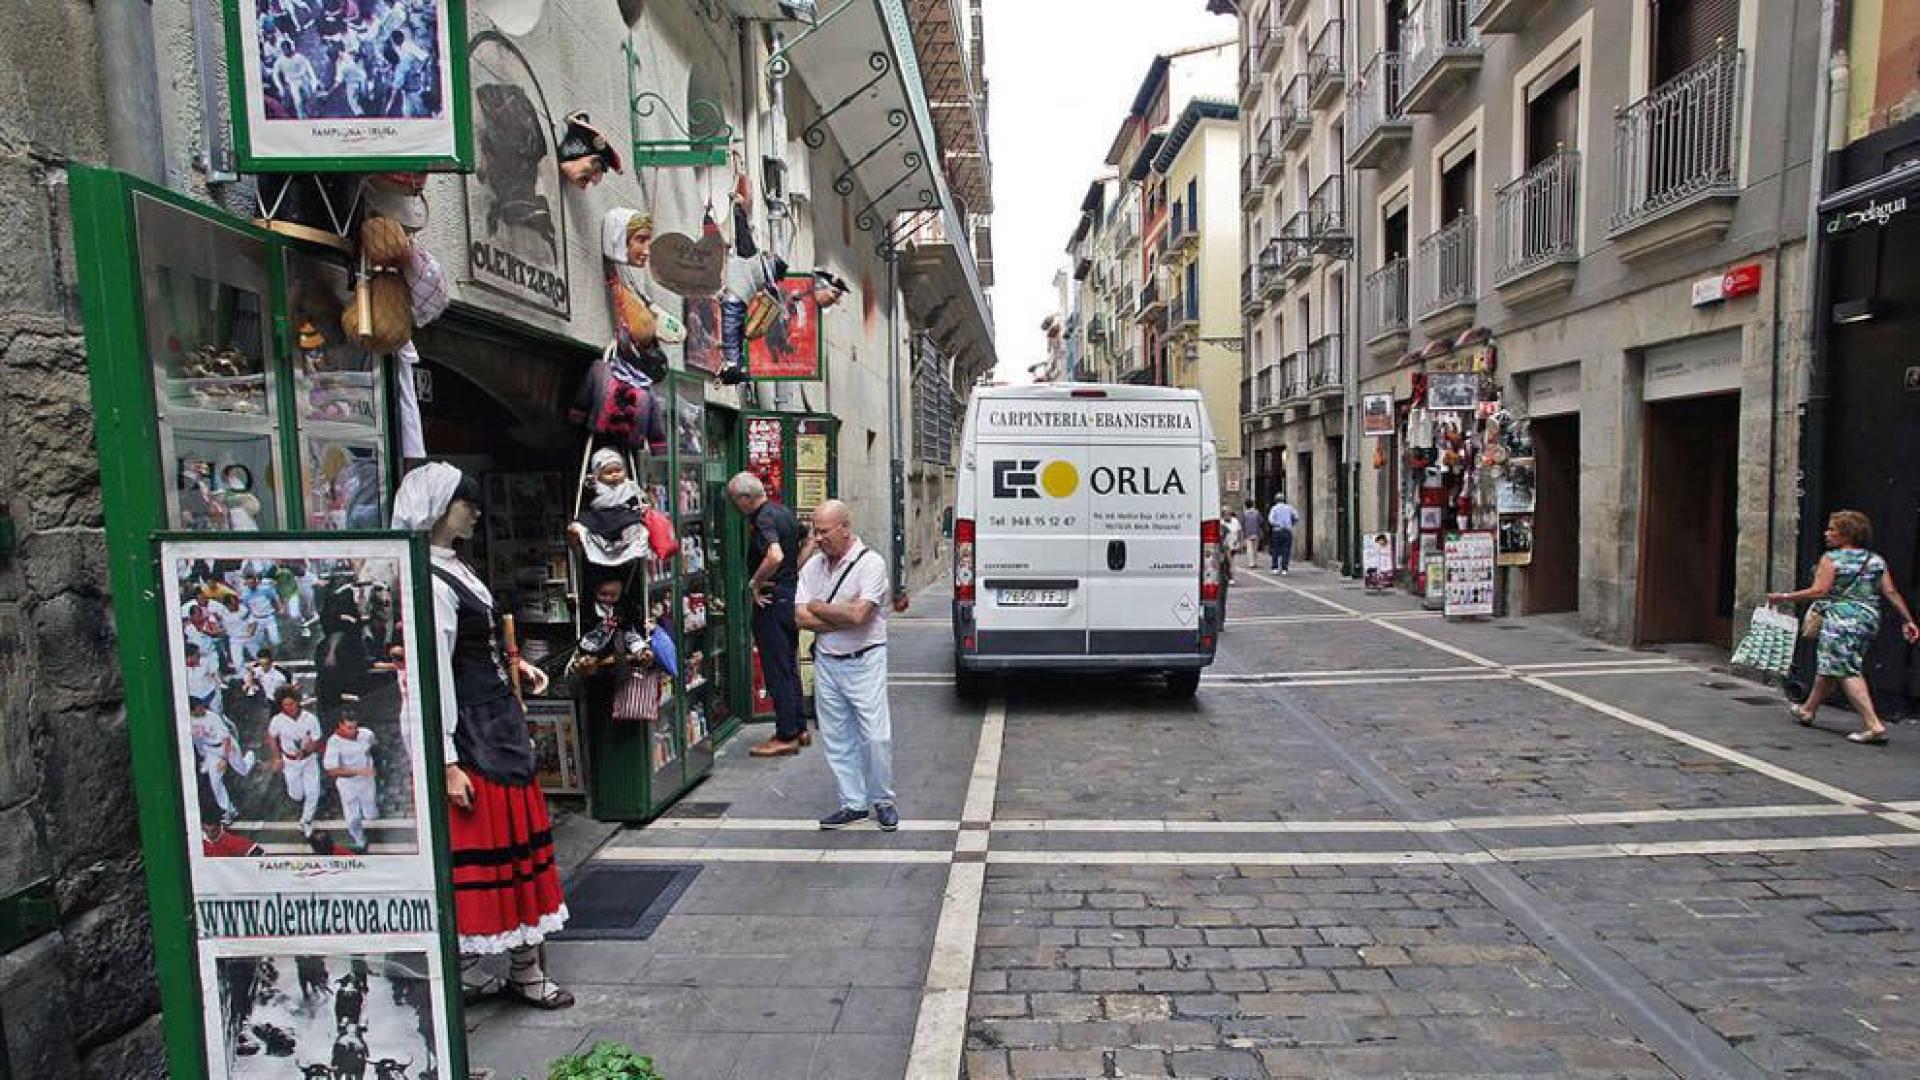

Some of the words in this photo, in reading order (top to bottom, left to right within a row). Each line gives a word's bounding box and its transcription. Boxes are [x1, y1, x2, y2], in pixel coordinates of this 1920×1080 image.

[472, 241, 566, 307] OLENTZERO
[1090, 466, 1186, 496] ORLA
[259, 860, 322, 871] PAMPLONA
[200, 891, 433, 938] www.olentzeroa.com
